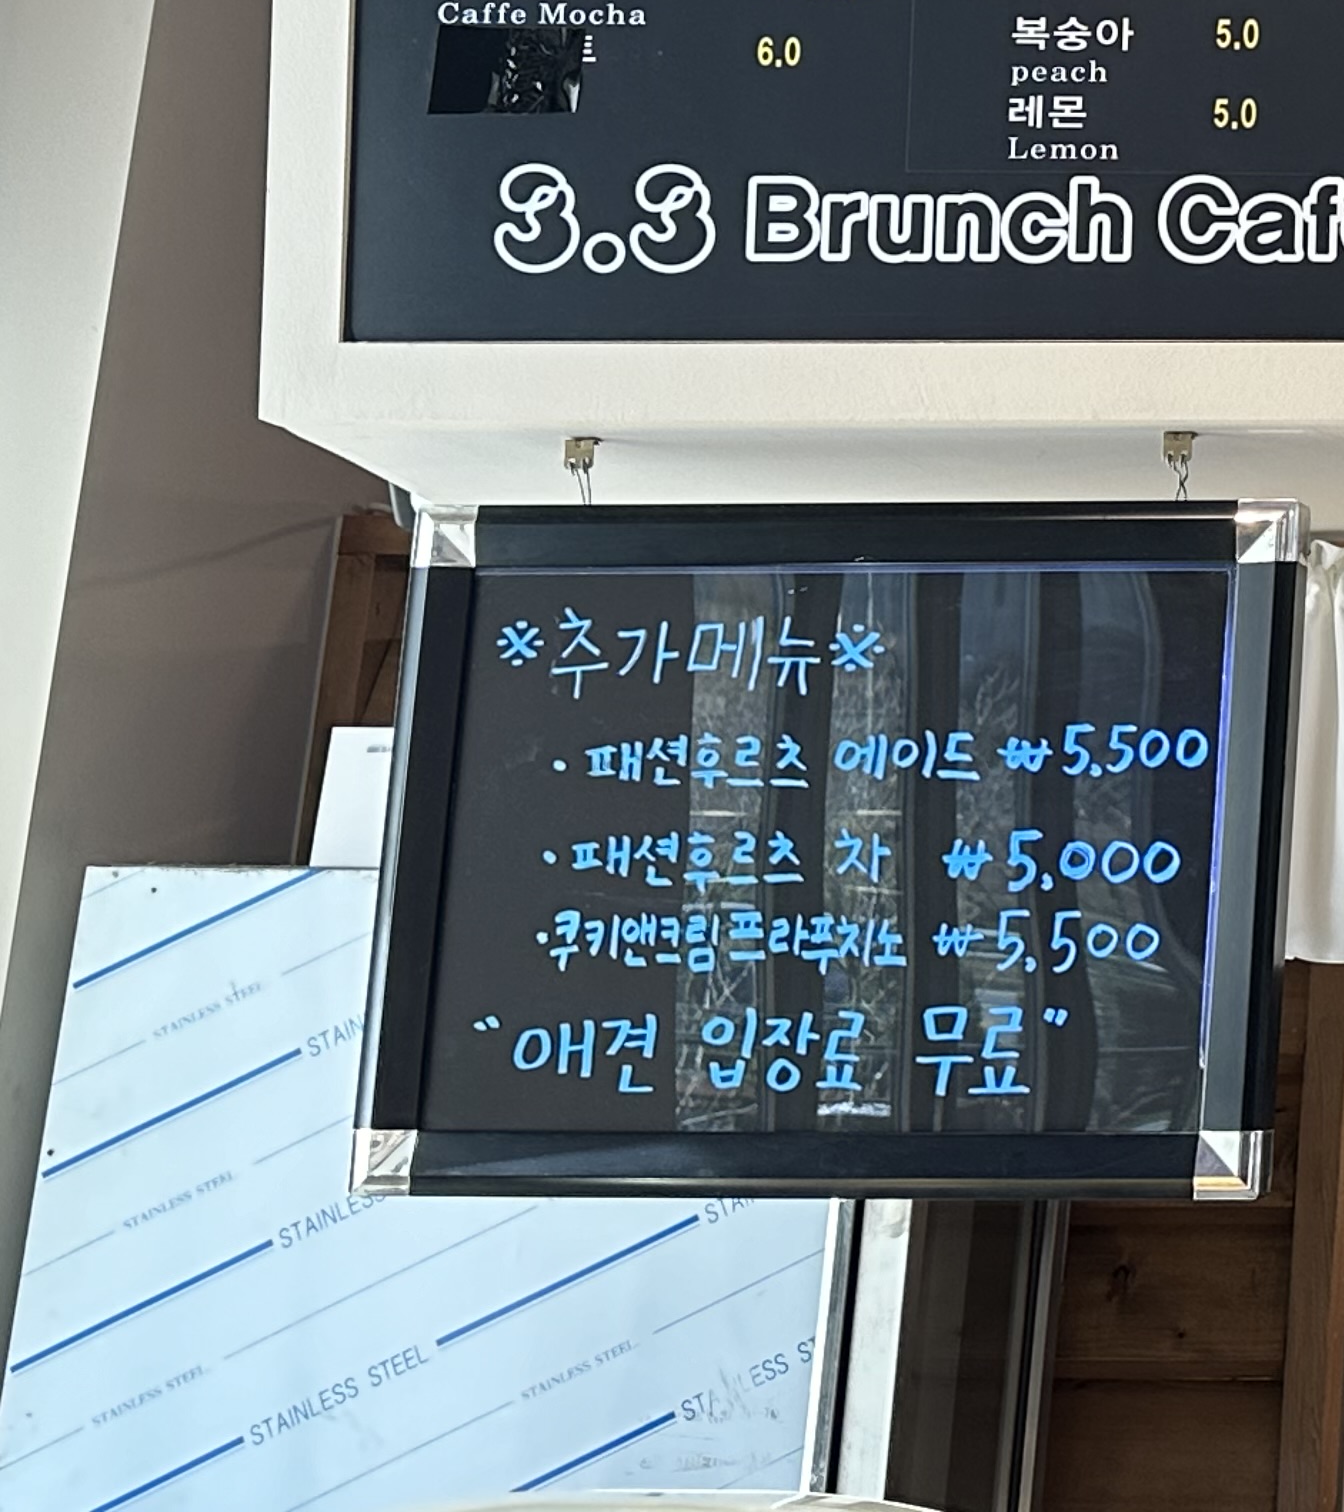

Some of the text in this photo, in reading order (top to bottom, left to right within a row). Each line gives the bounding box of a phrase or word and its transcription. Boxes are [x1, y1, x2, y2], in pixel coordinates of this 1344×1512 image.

[757, 36, 801, 68] 6.0
[1011, 16, 1135, 52] 복숭아
[1215, 18, 1260, 51] 5.0
[1010, 59, 1108, 87] peach
[1008, 94, 1088, 129] 레몬
[1007, 136, 1119, 161] Lemon
[493, 162, 717, 275] 3.3
[744, 174, 1133, 265] Brunch
[584, 732, 810, 789] 패션후르츠
[833, 729, 981, 781] 에이드
[571, 829, 804, 894] 패션후르츠
[834, 828, 891, 883] 차
[701, 1013, 863, 1092] 입장료
[249, 1344, 429, 1446] STAINLESS STEEL
